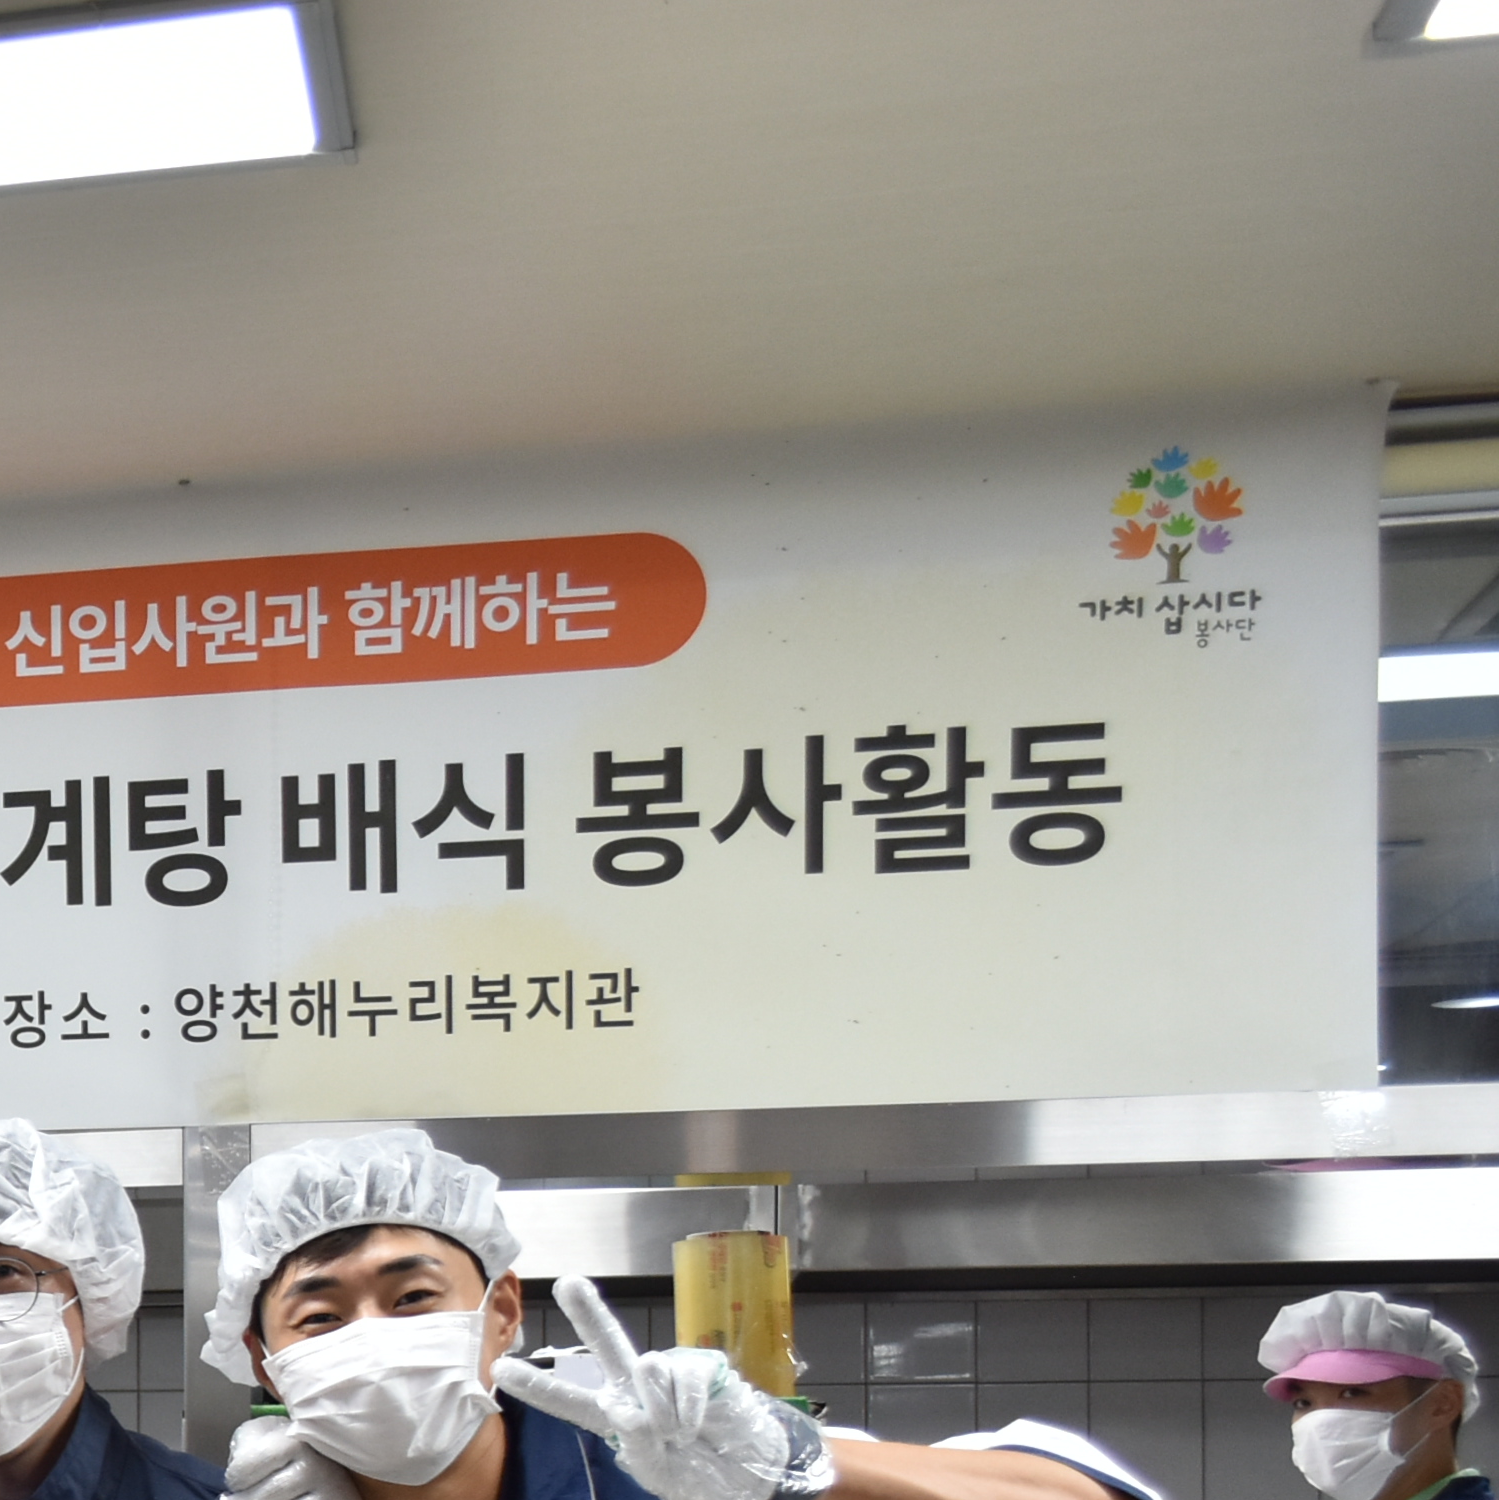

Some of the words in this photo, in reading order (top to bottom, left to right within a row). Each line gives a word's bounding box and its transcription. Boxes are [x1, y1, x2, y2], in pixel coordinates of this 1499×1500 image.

[4, 586, 328, 678] 신입사원과
[344, 571, 616, 657] 함께하는
[1079, 596, 1144, 621] 가치
[1155, 589, 1263, 635] 삽시다
[1195, 618, 1256, 649] 봉사단
[280, 752, 526, 893] 배식
[575, 721, 1124, 888] 봉사활동
[3, 989, 110, 1049] 장소
[173, 967, 641, 1044] 양천해누리복지관
